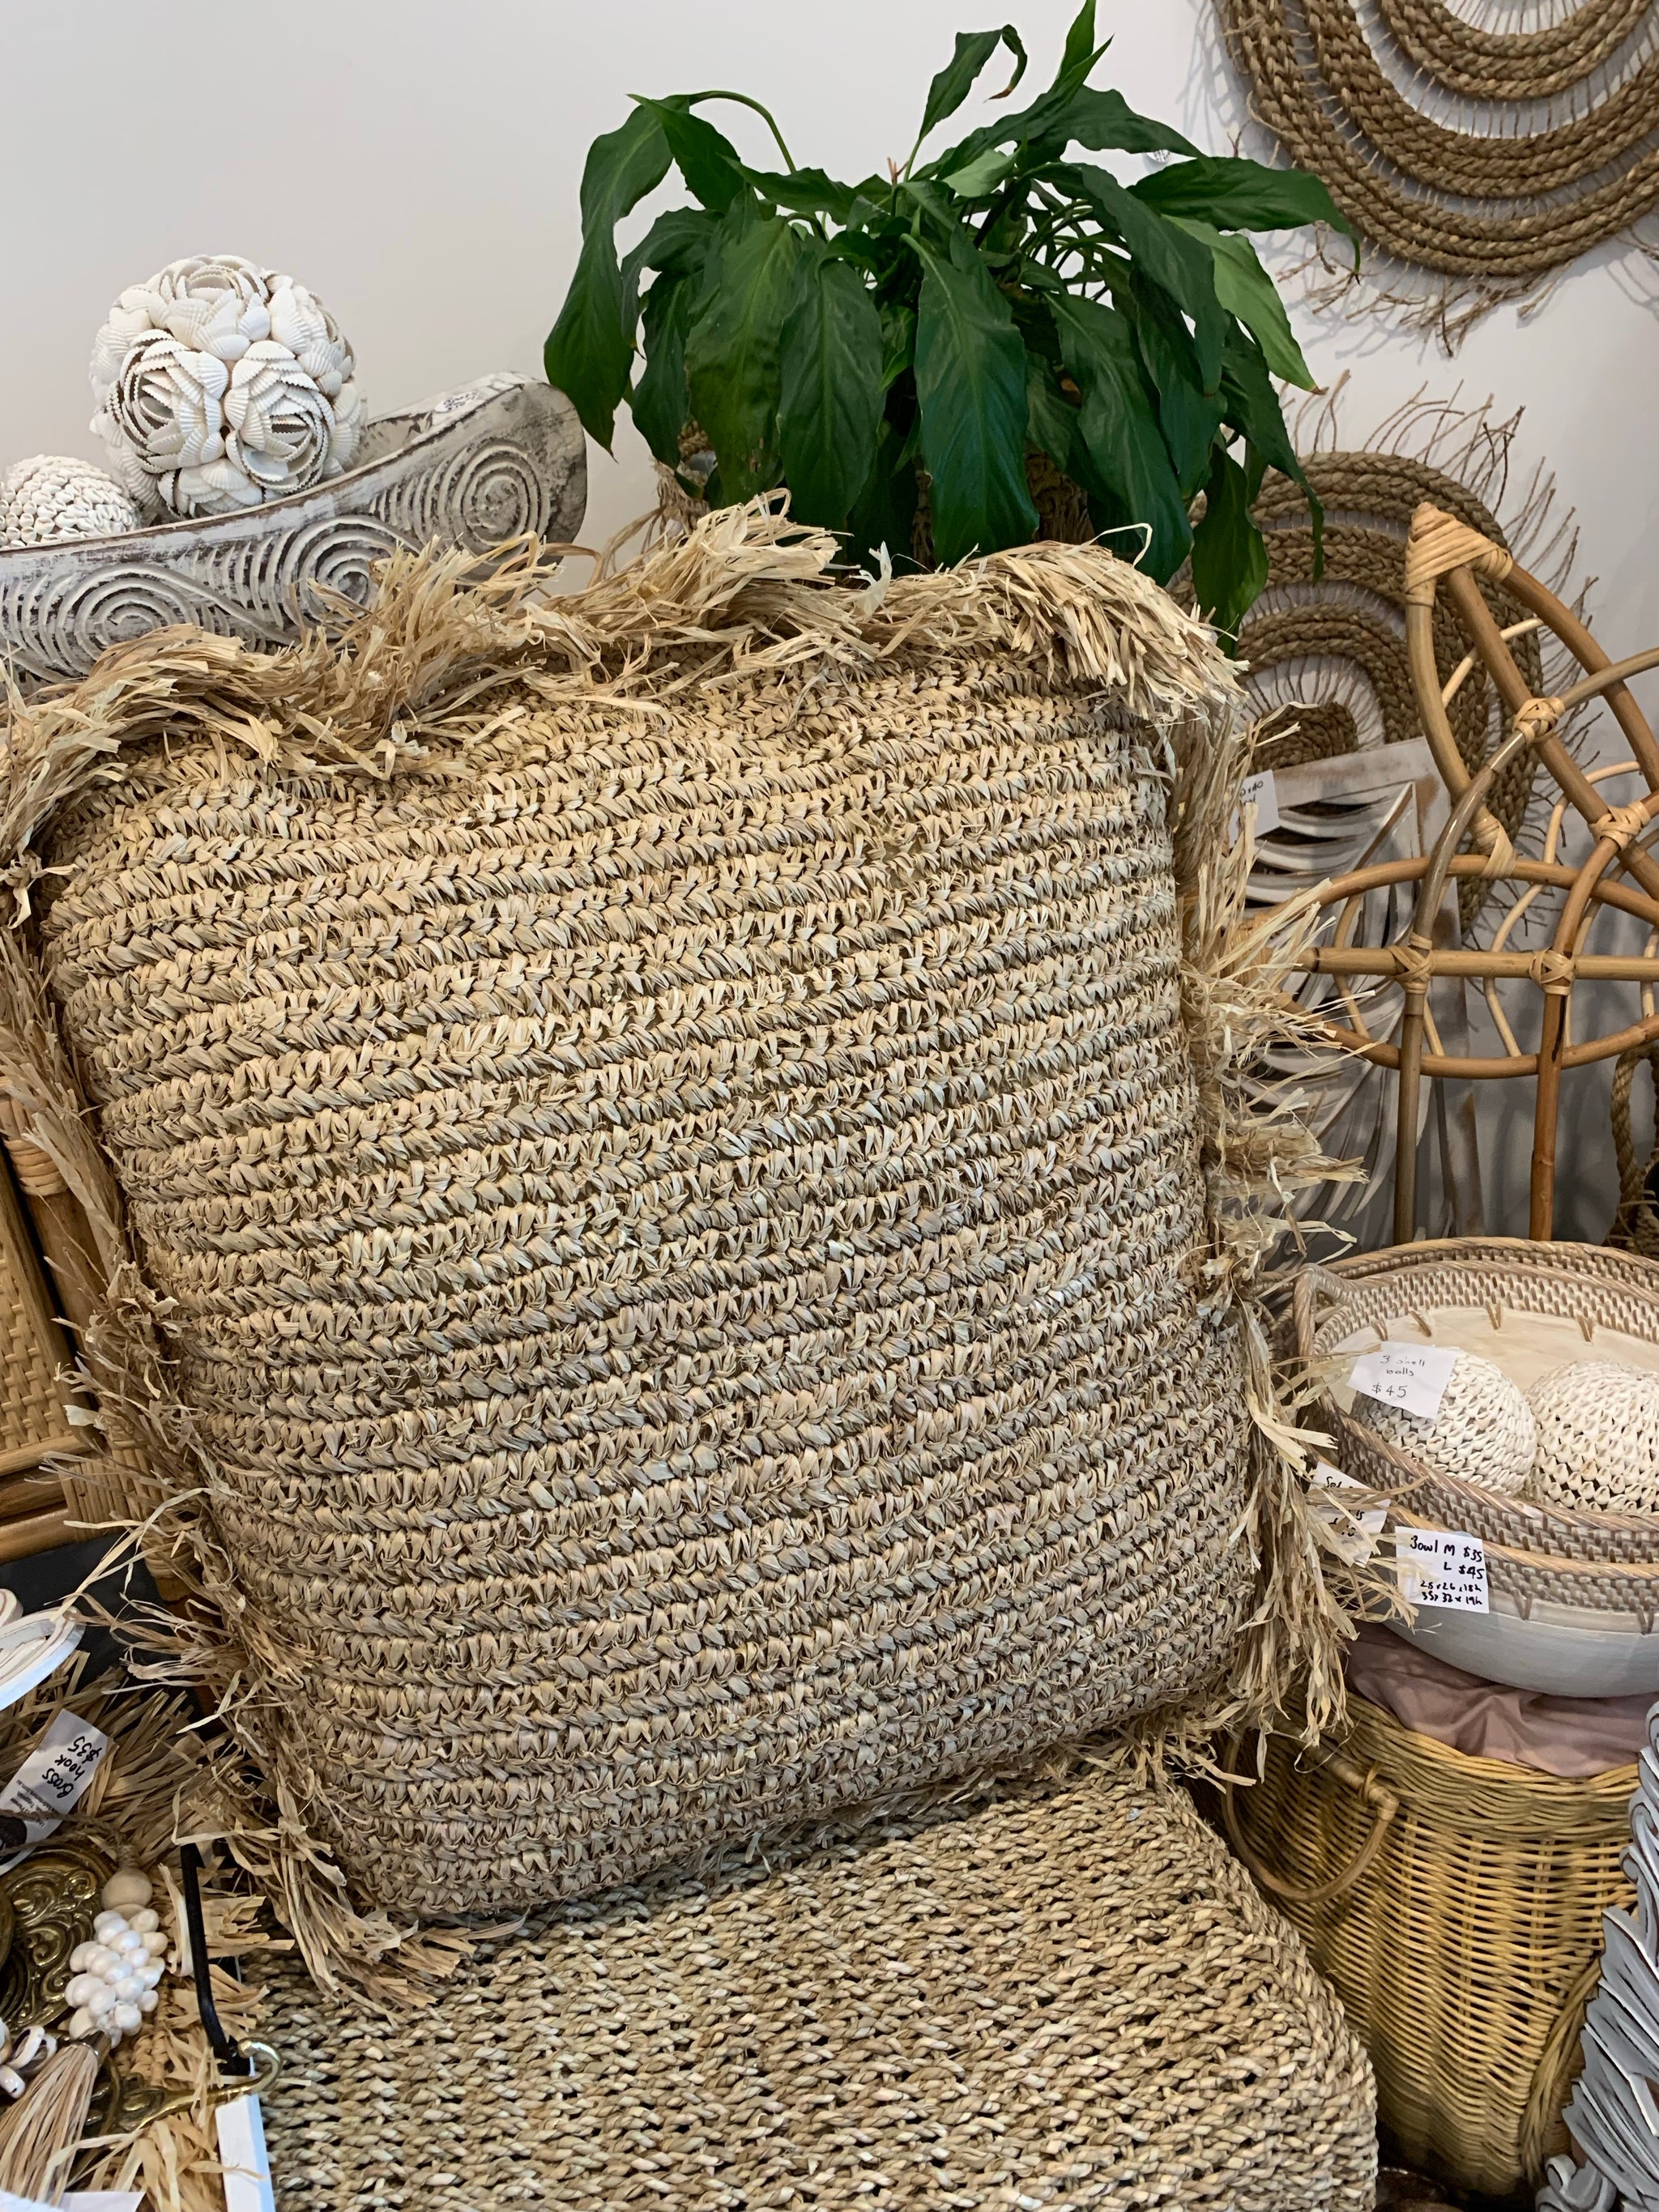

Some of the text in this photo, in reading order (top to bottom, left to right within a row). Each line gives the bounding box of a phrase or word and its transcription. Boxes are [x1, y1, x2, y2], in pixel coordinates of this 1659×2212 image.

[1380, 1355, 1390, 1364] 3
[1371, 1382, 1408, 1399] $45
[1444, 1545, 1455, 1556] M
[1463, 1546, 1482, 1562] $35
[1444, 1562, 1485, 1579] L $45
[67, 1736, 102, 1764] $35
[54, 1754, 85, 1781] hook
[42, 1768, 74, 1798] Brass
